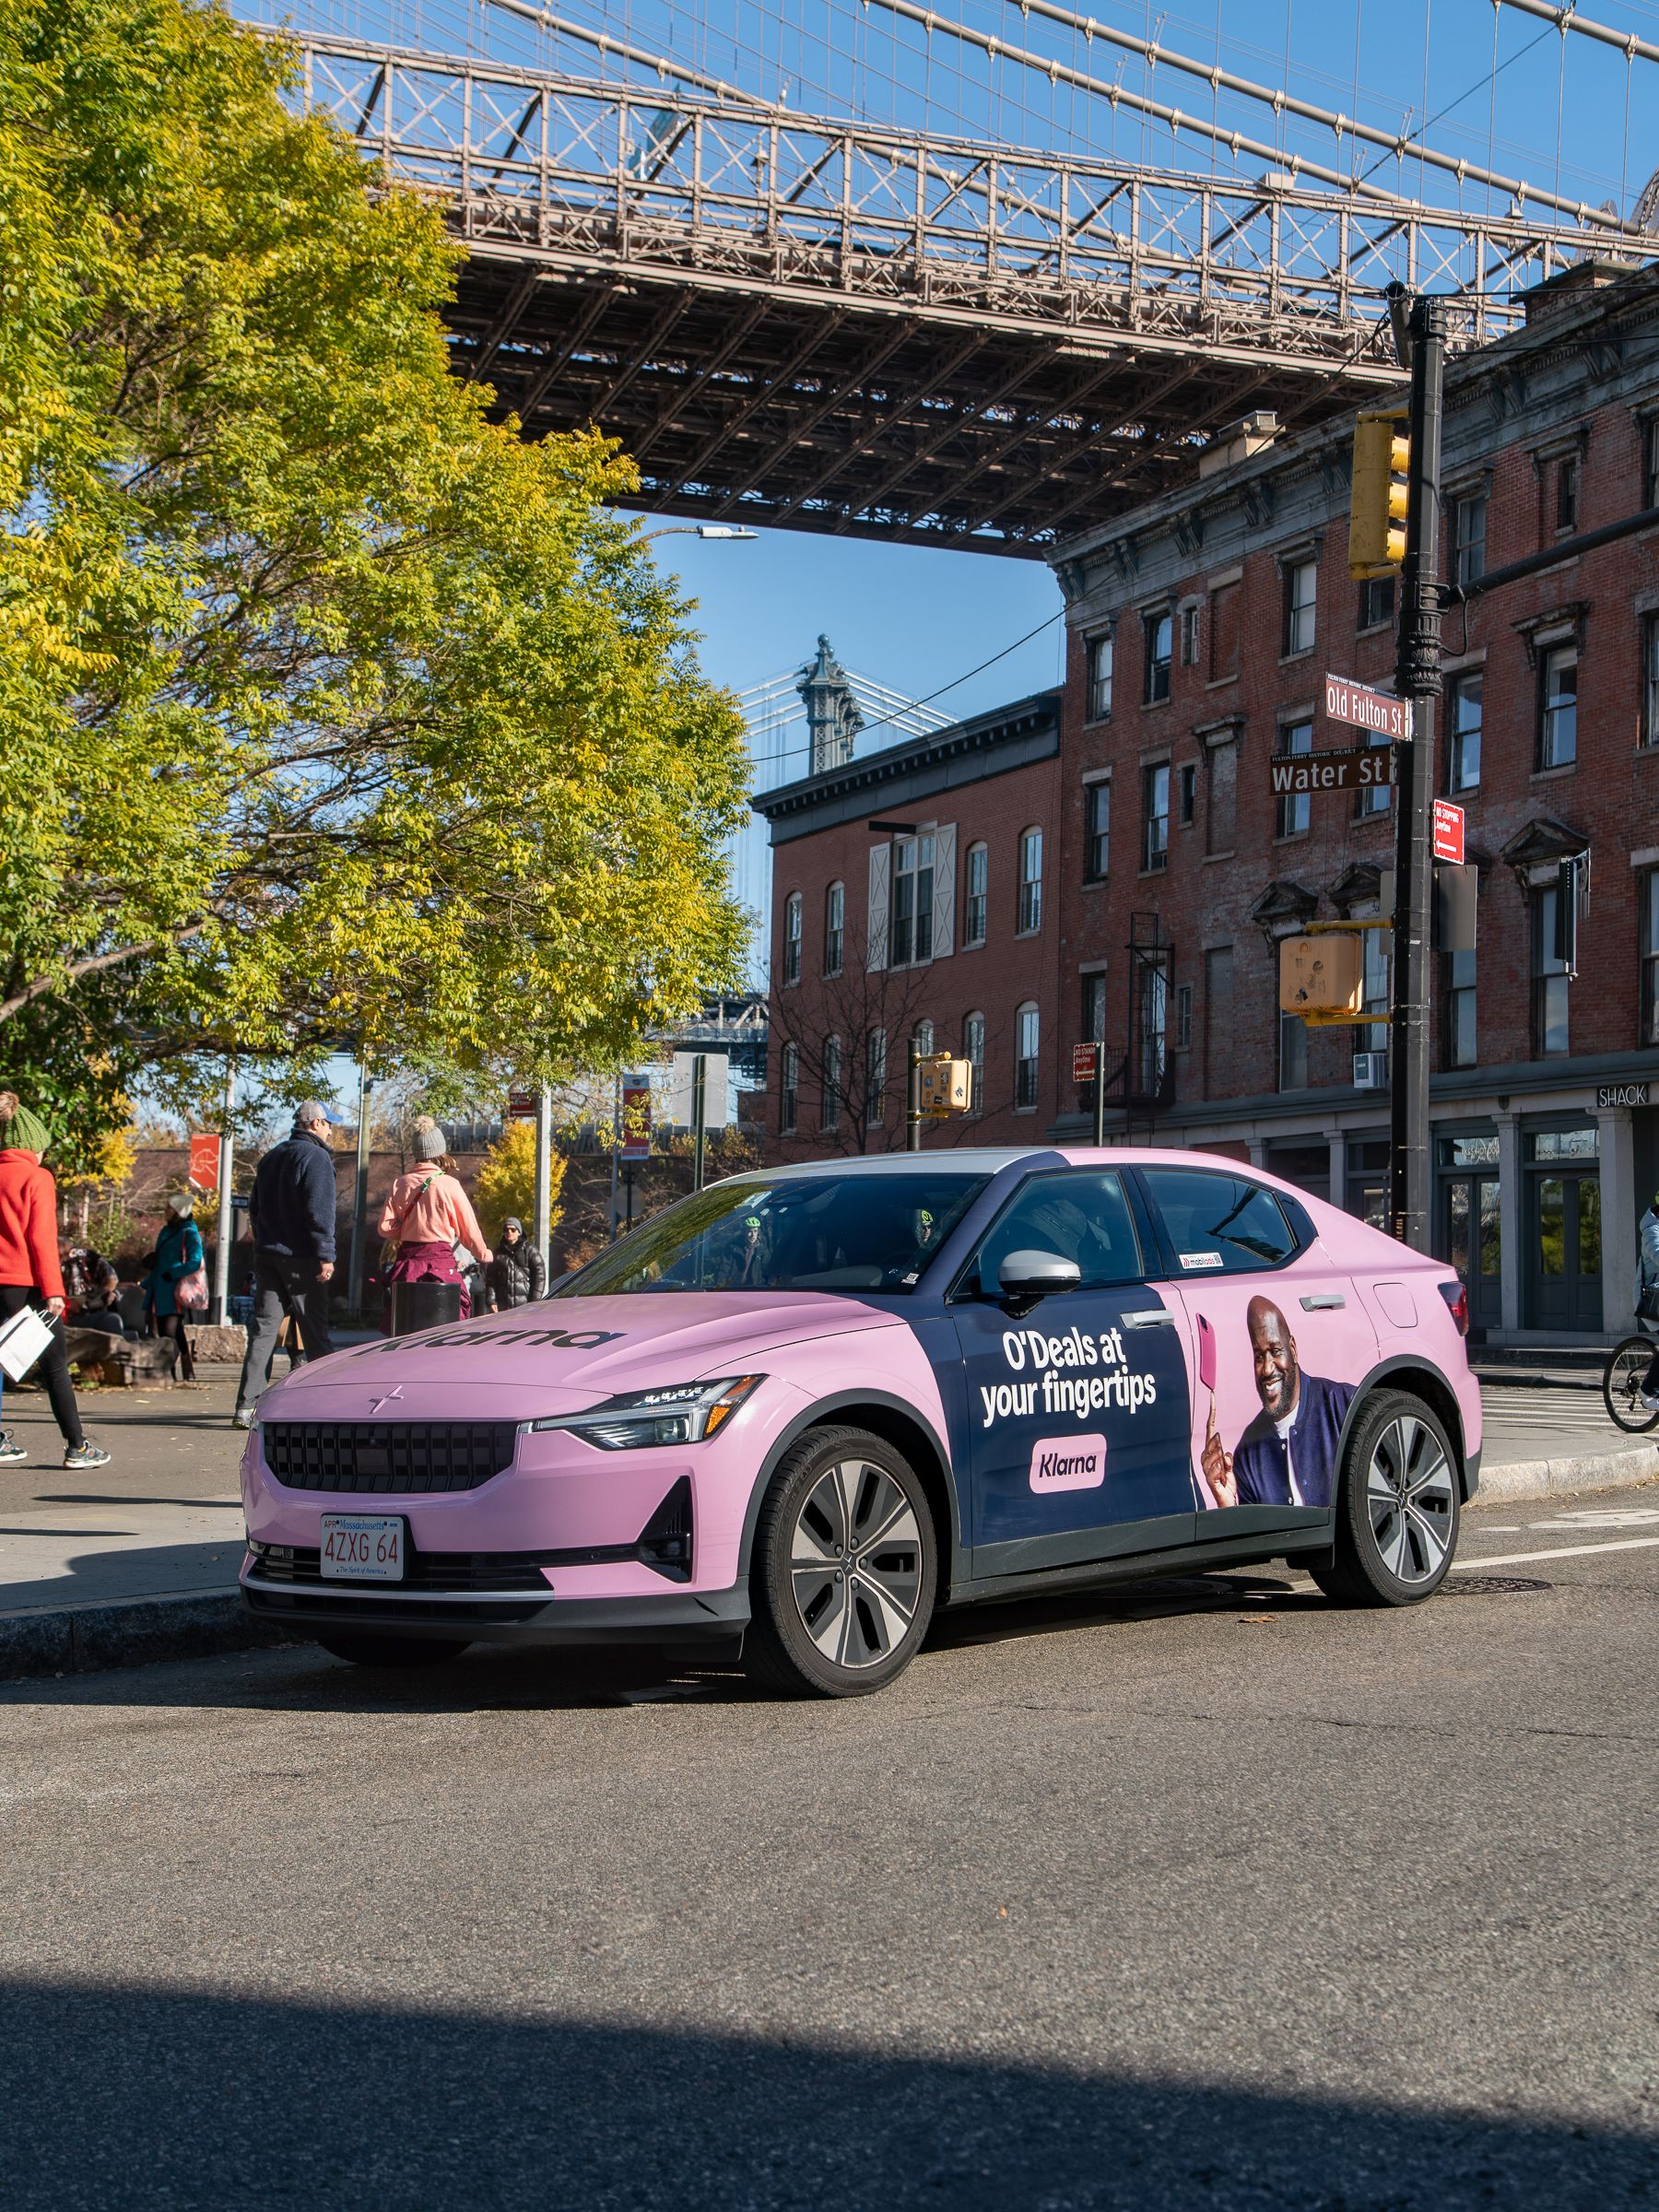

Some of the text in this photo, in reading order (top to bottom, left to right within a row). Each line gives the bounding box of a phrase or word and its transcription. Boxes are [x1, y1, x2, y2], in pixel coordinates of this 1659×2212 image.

[1327, 687, 1402, 735] Old Fulton St
[1272, 757, 1382, 792] Water St
[1436, 806, 1460, 824] NO STOPPING
[1599, 1085, 1646, 1107] SHACK
[1002, 1326, 1126, 1371] O'Deals at
[981, 1364, 1157, 1428] your fingertips
[1039, 1453, 1097, 1477] Klarna
[324, 1520, 336, 1528] APR
[339, 1519, 384, 1530] Massachusetts
[324, 1532, 398, 1564] 4ZXG 64
